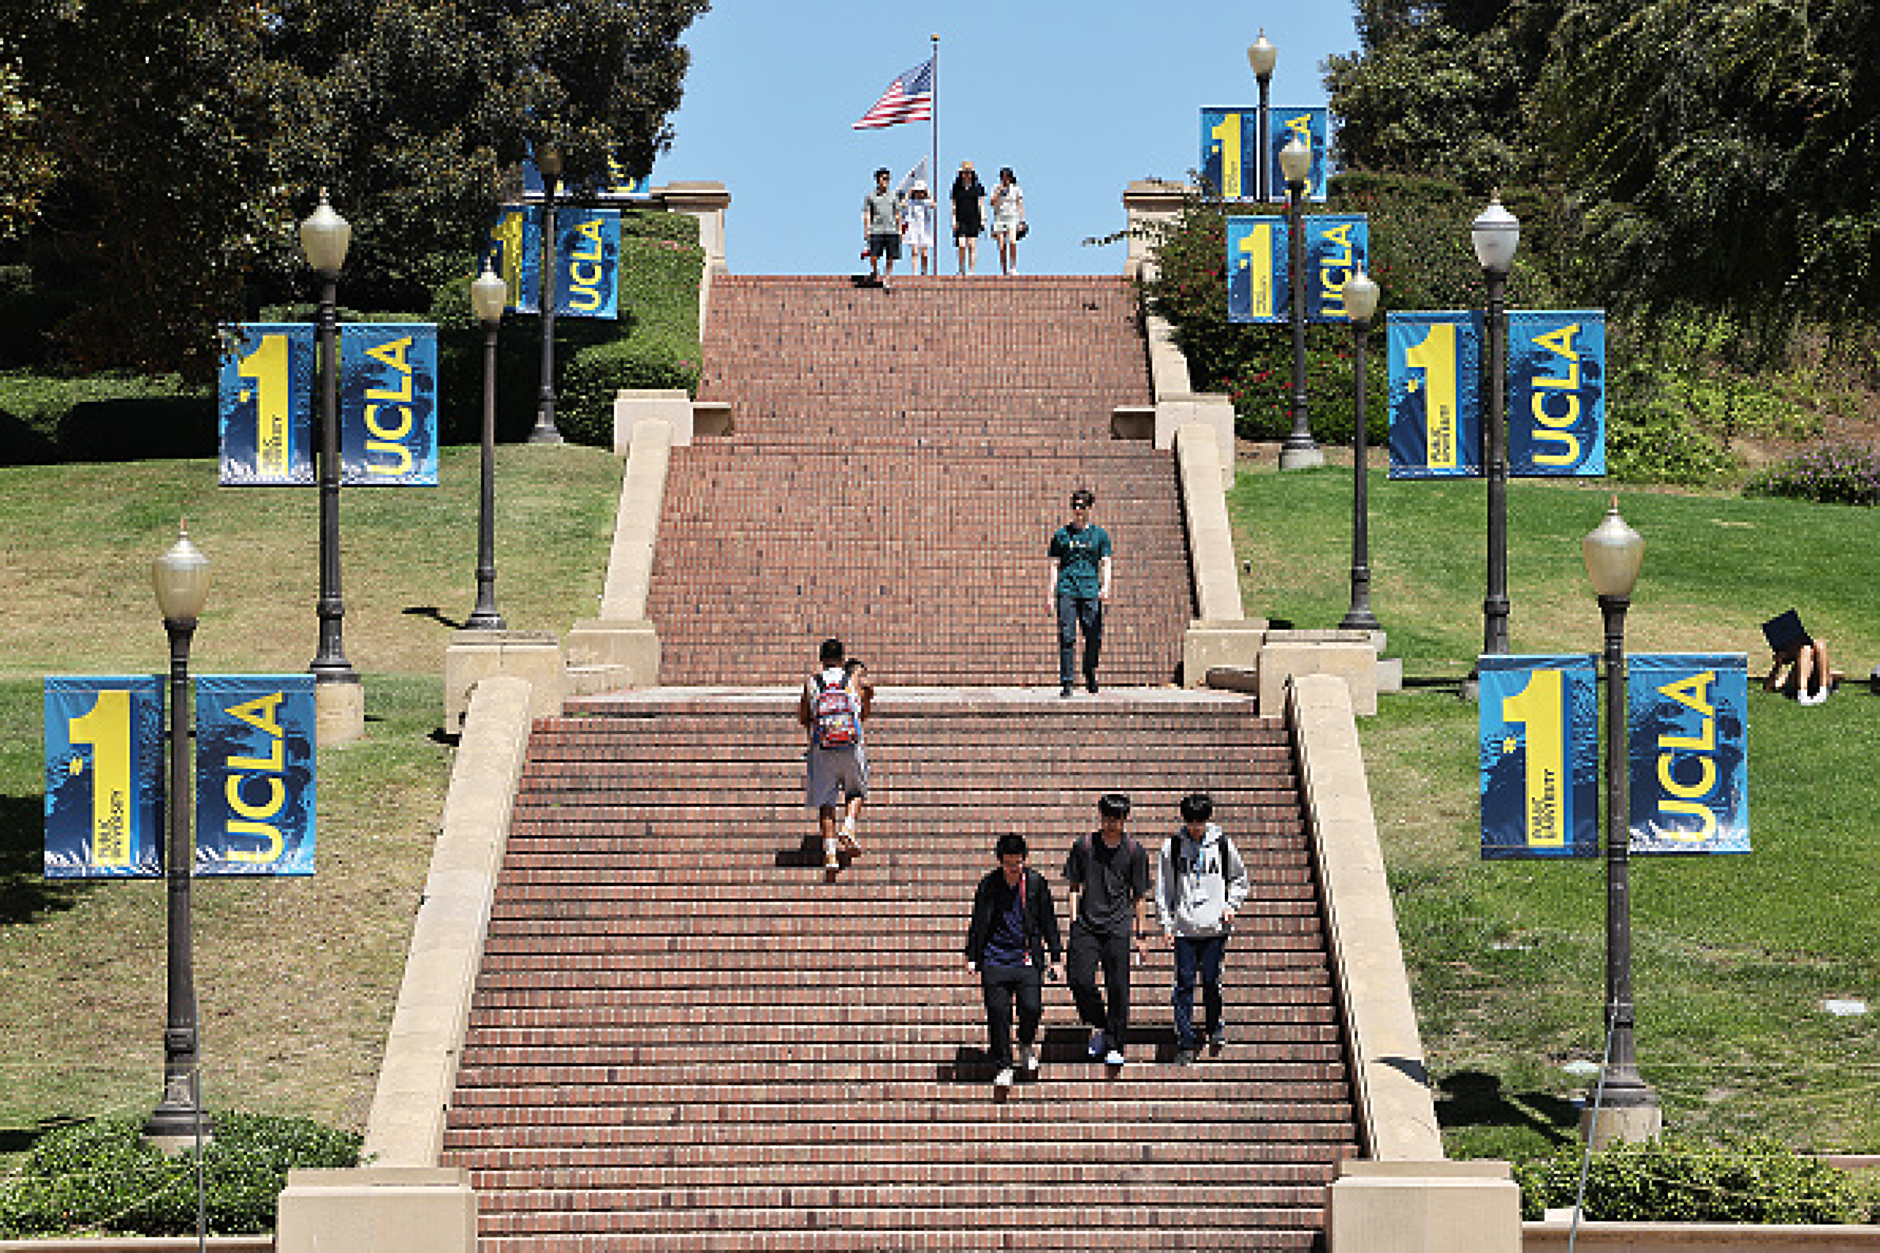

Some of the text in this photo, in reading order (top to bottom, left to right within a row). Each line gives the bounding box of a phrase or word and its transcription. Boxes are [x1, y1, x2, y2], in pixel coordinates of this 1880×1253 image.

[569, 218, 604, 311] UCLA
[1320, 224, 1352, 317] UCLA
[363, 335, 412, 475] UCLA
[1531, 322, 1580, 465] UCLA
[225, 690, 285, 863] UCLA
[1656, 670, 1716, 843] UCLA
